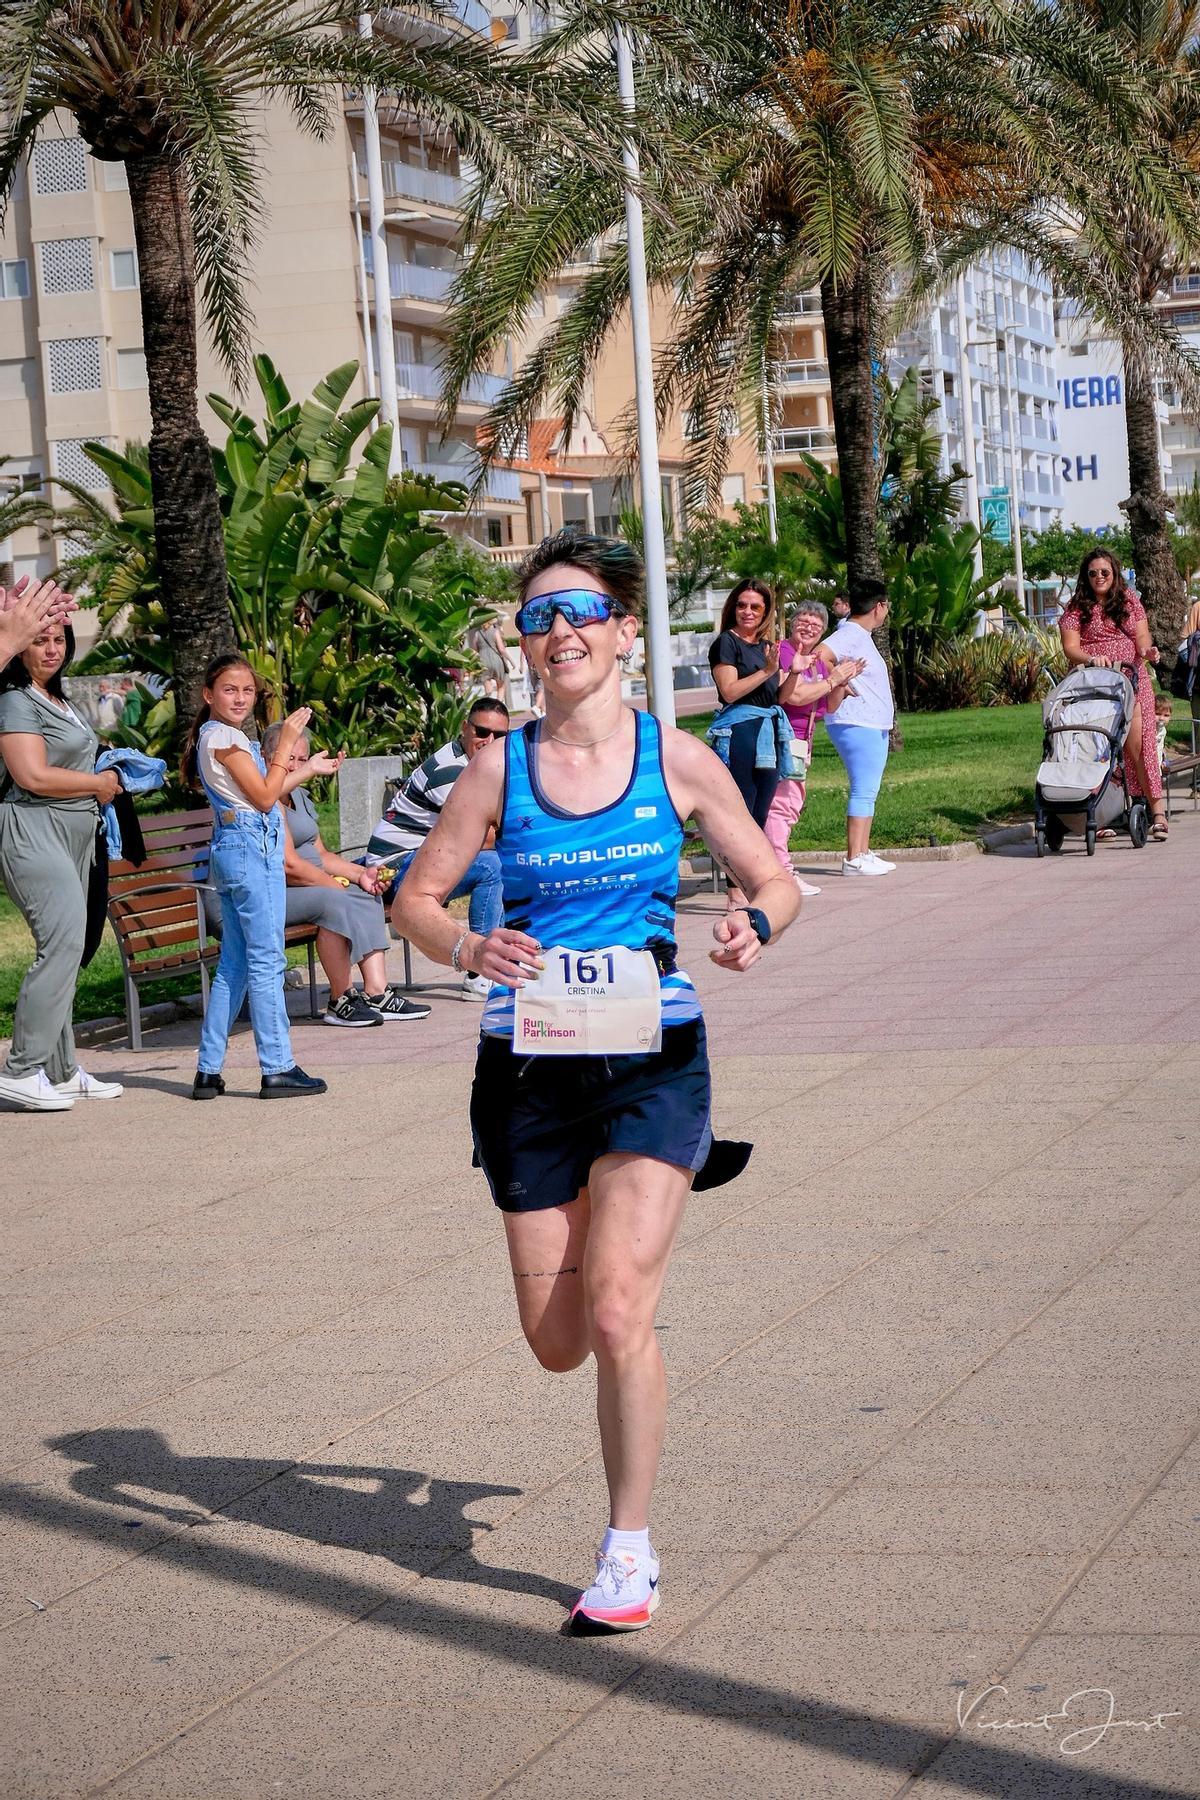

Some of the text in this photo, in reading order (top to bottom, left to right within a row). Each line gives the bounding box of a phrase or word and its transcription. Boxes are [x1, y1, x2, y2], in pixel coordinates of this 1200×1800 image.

[538, 873, 637, 889] FIPSER
[541, 882, 638, 896] Mediterranea
[558, 952, 615, 984] 161
[567, 986, 606, 996] CRISTINA
[523, 1017, 543, 1029] Run
[523, 1027, 576, 1038] Parkinson
